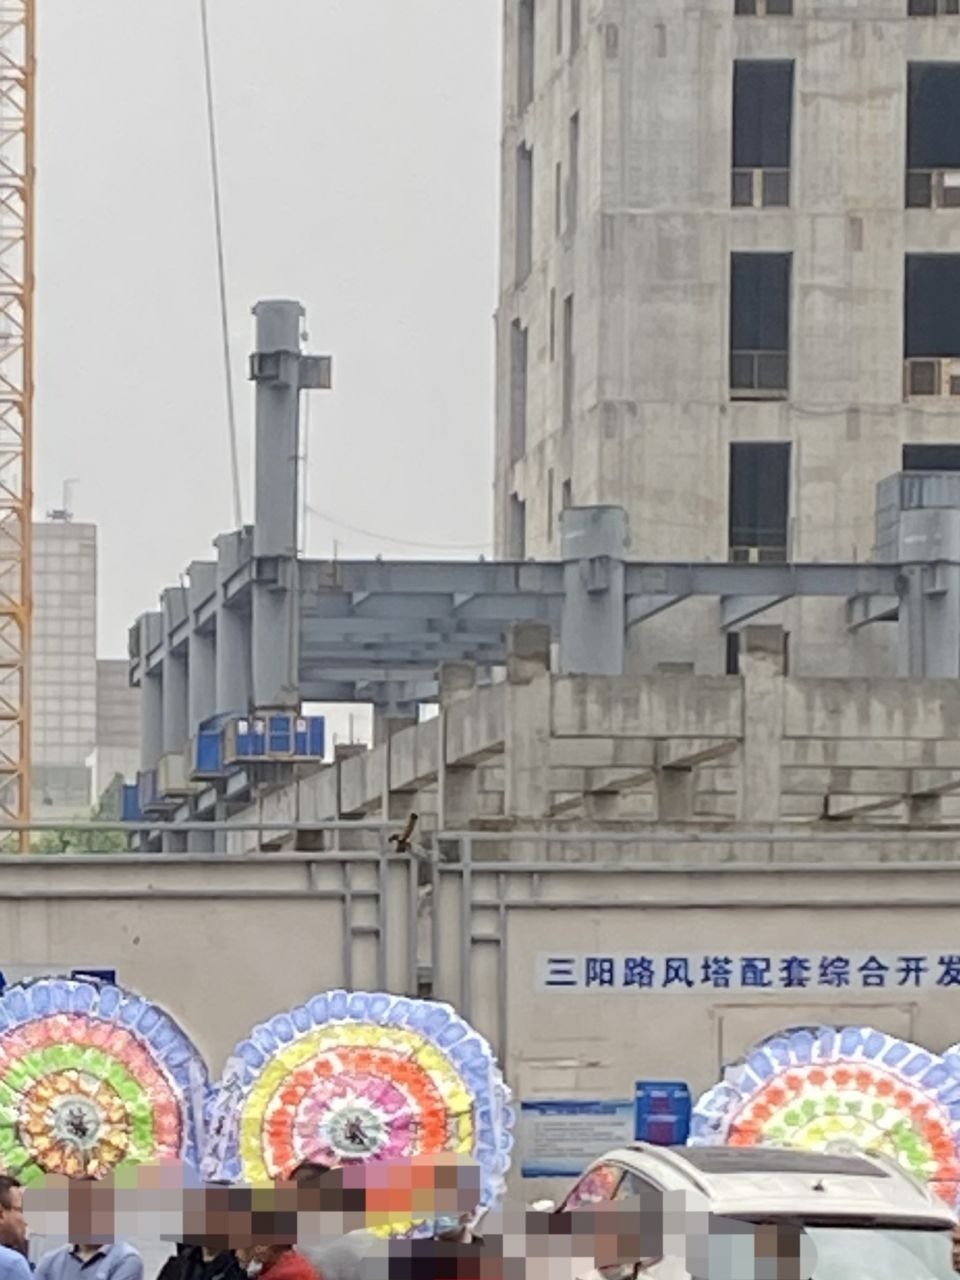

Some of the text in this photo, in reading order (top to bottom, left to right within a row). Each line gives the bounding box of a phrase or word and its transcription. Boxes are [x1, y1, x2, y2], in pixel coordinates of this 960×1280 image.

[546, 955, 960, 987] 三阳路风塔配套综合开发
